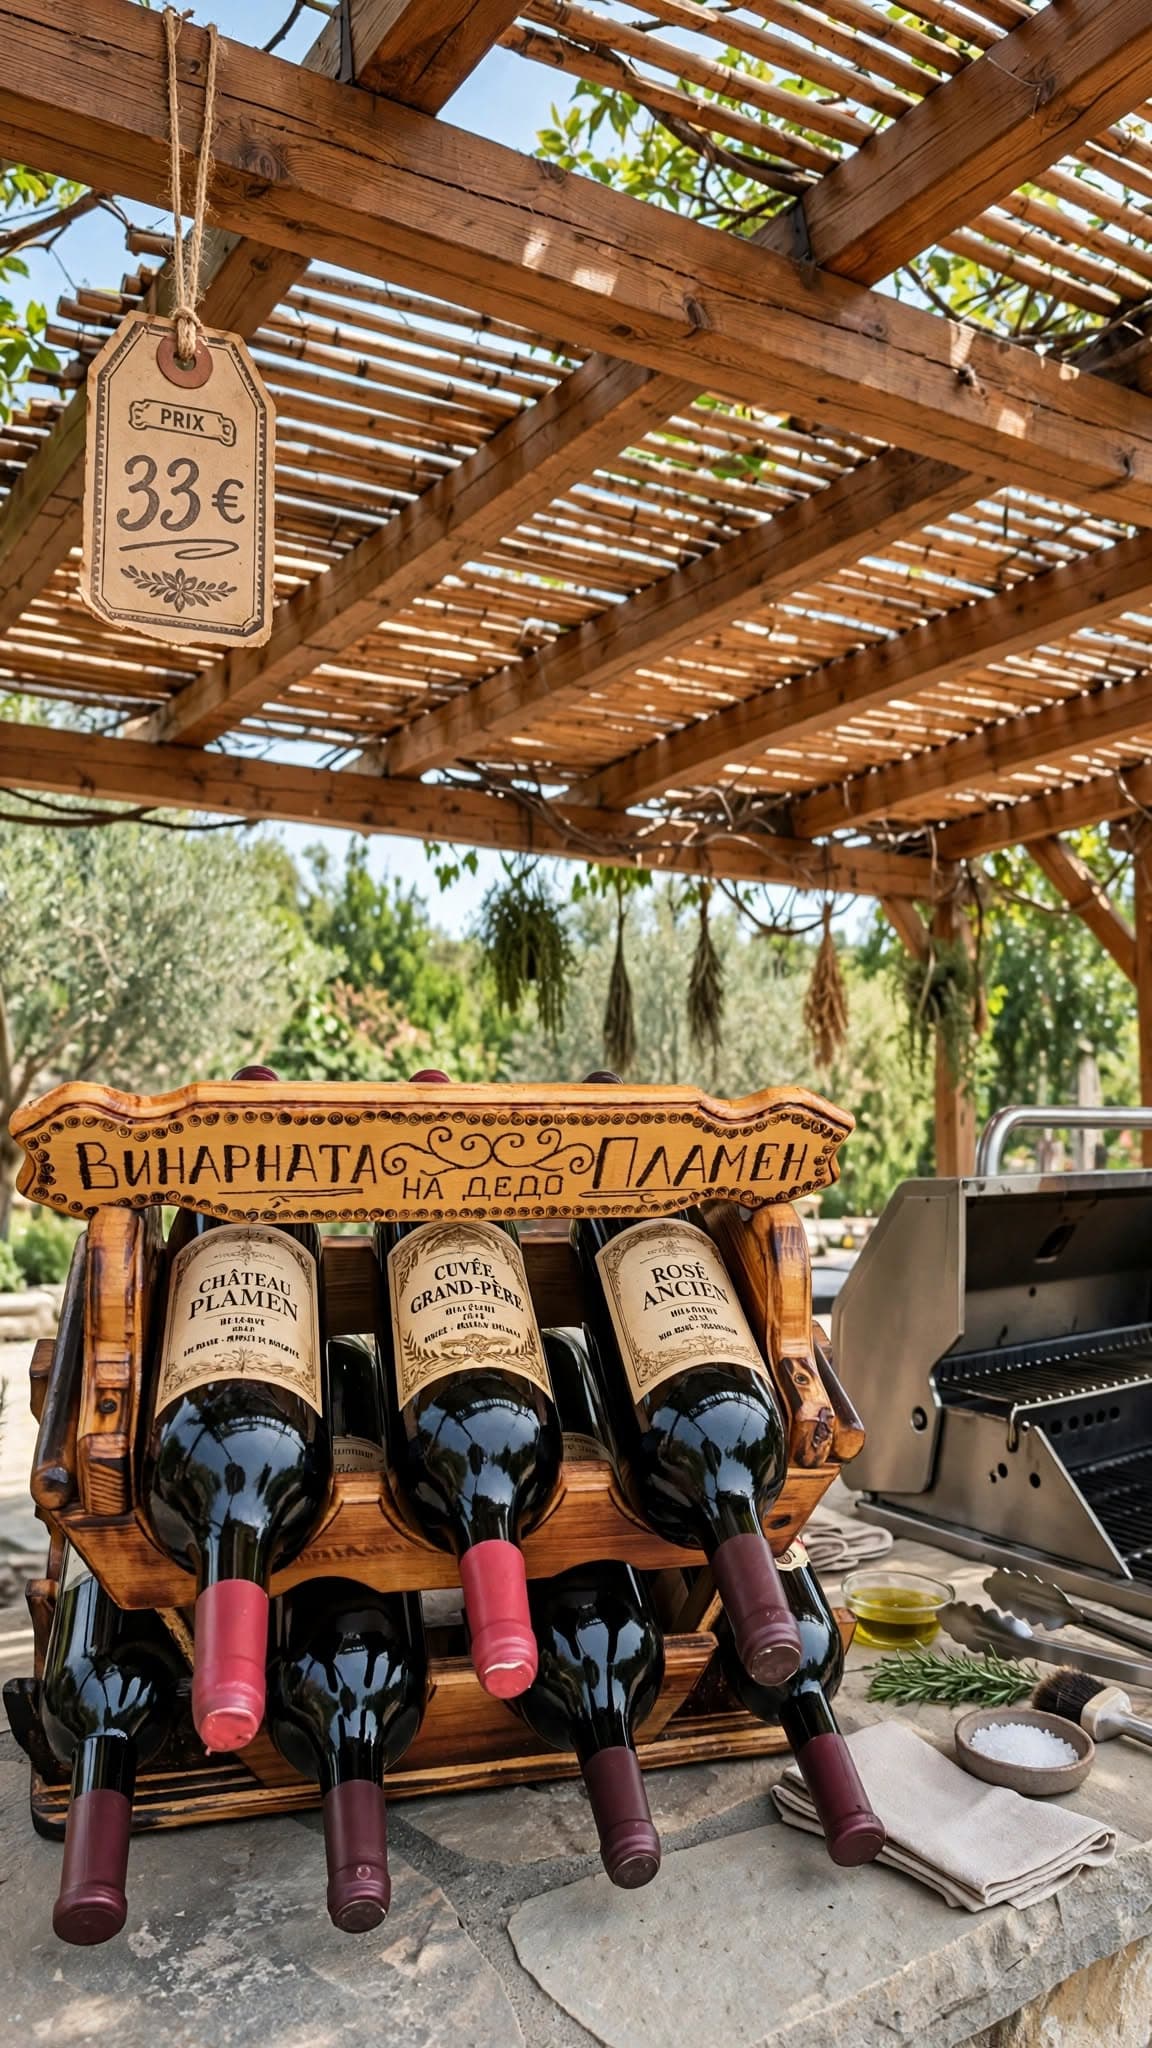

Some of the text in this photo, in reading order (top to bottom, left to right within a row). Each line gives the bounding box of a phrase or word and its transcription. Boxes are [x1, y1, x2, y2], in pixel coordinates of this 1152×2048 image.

[160, 407, 205, 432] PRIX
[76, 1136, 809, 1202] ВИНАРНАТА НА ДЕДО ПЛАМЕН
[199, 1268, 291, 1296] CHÂTEAU
[650, 1261, 709, 1284] ROSÉ
[188, 1288, 298, 1322] PLAMEN
[410, 1279, 524, 1314] GRAND-PÈRE
[643, 1280, 730, 1311] ANCIEN
